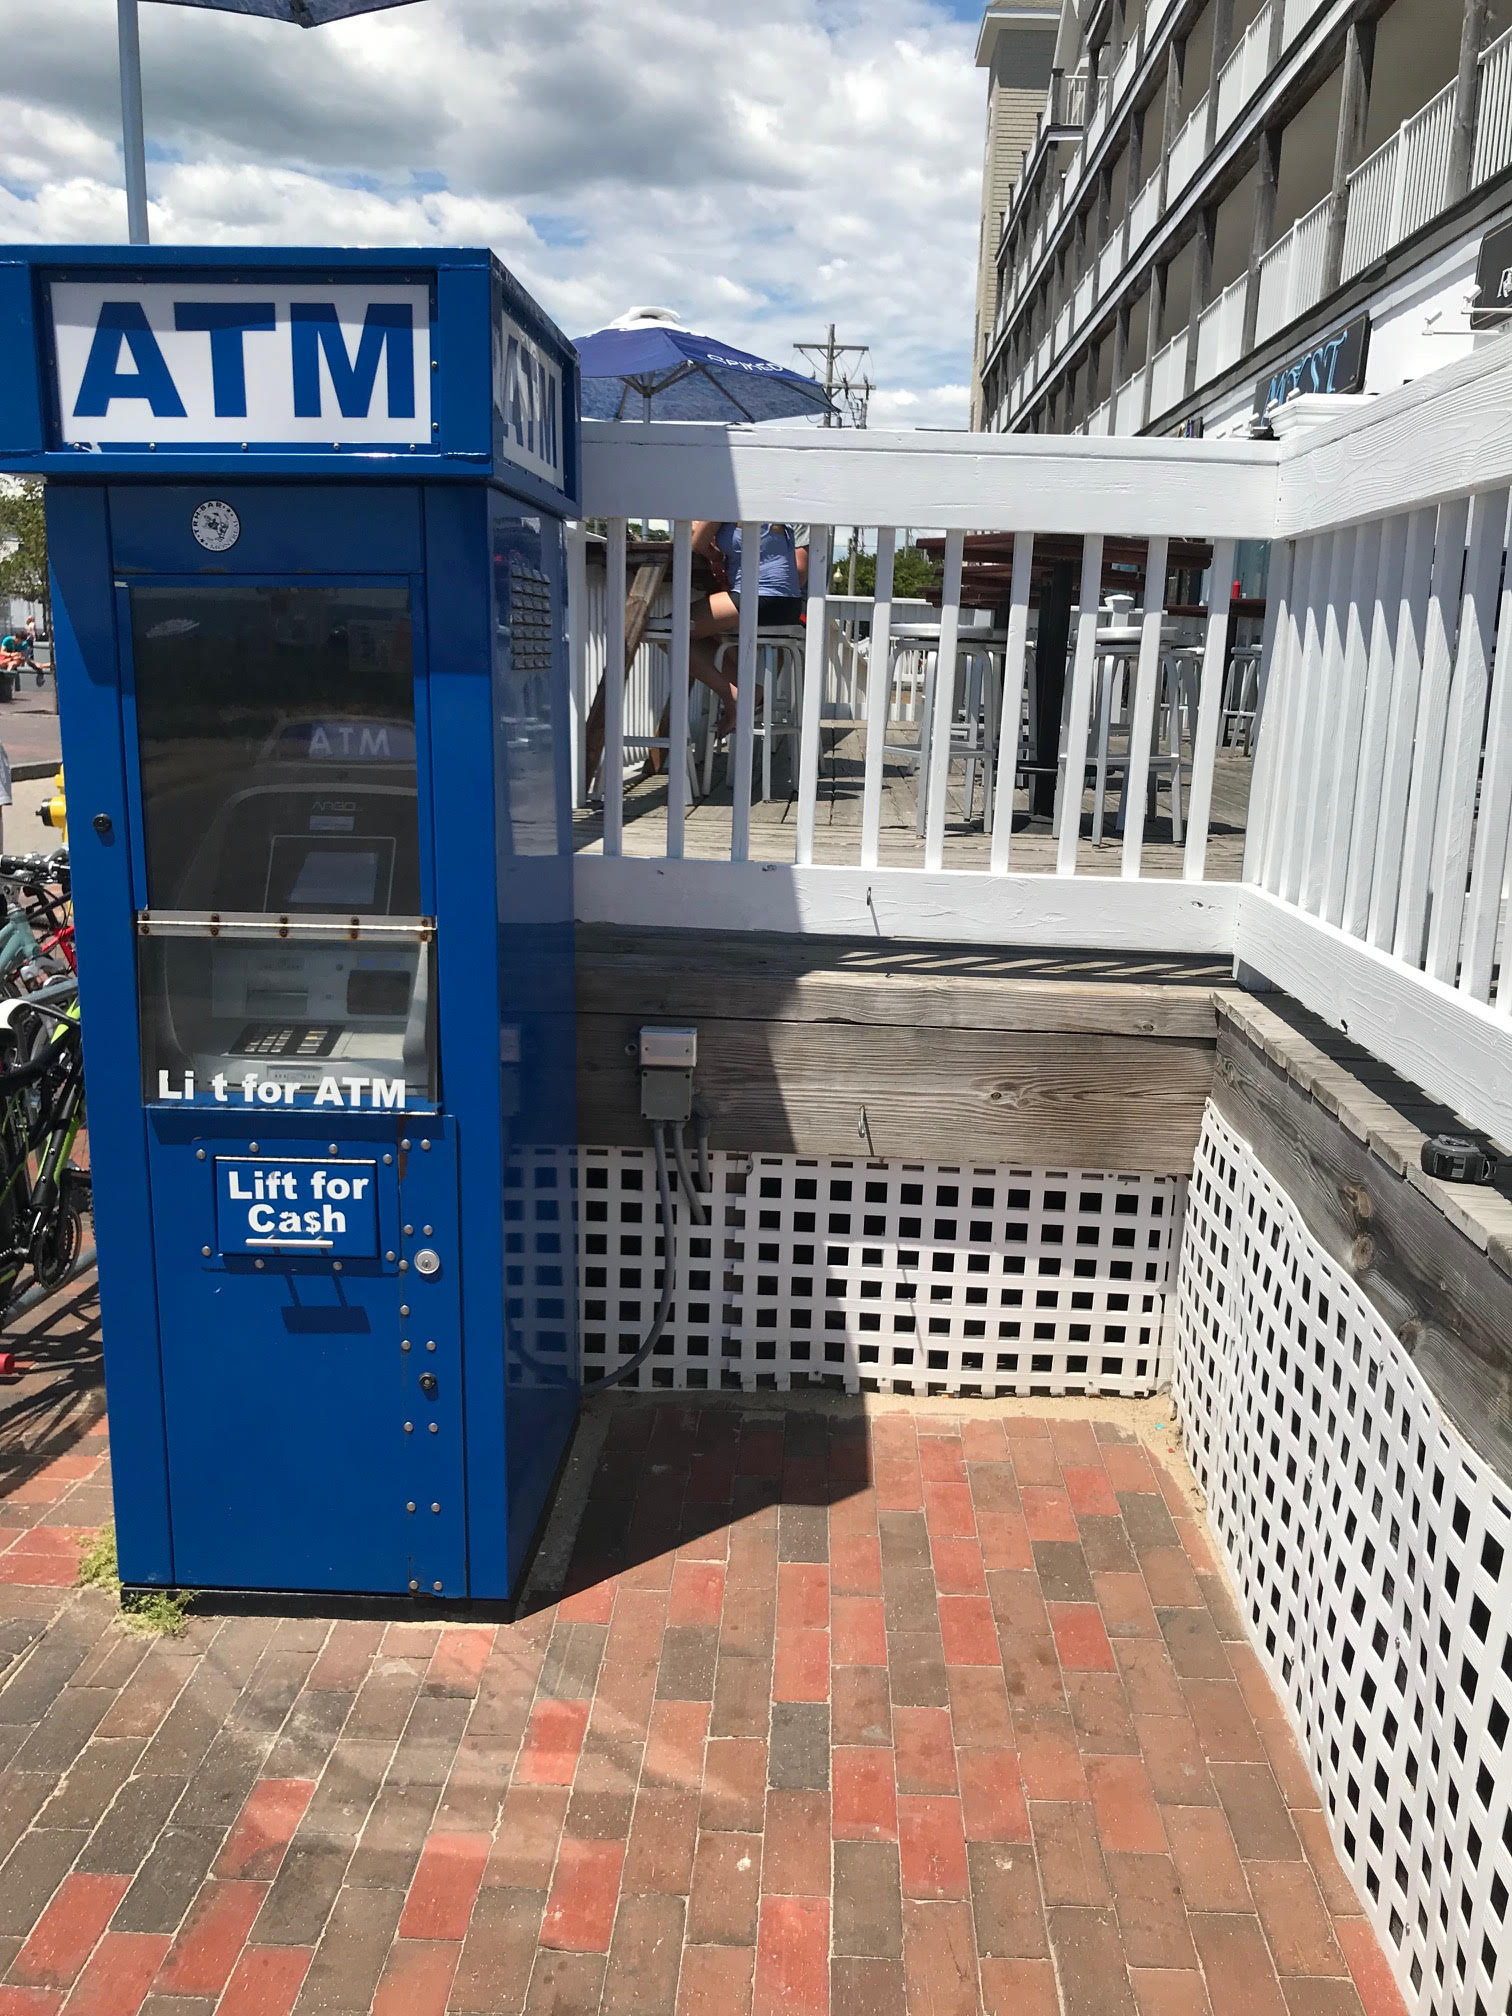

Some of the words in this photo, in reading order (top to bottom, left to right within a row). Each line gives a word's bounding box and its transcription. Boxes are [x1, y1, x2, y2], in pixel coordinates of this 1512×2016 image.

[72, 301, 416, 419] ATM
[502, 333, 558, 470] ATM
[309, 727, 391, 756] ATM
[241, 1072, 301, 1104] for
[313, 1076, 406, 1109] ATM
[228, 1170, 298, 1200] Lift
[310, 1170, 370, 1200] for
